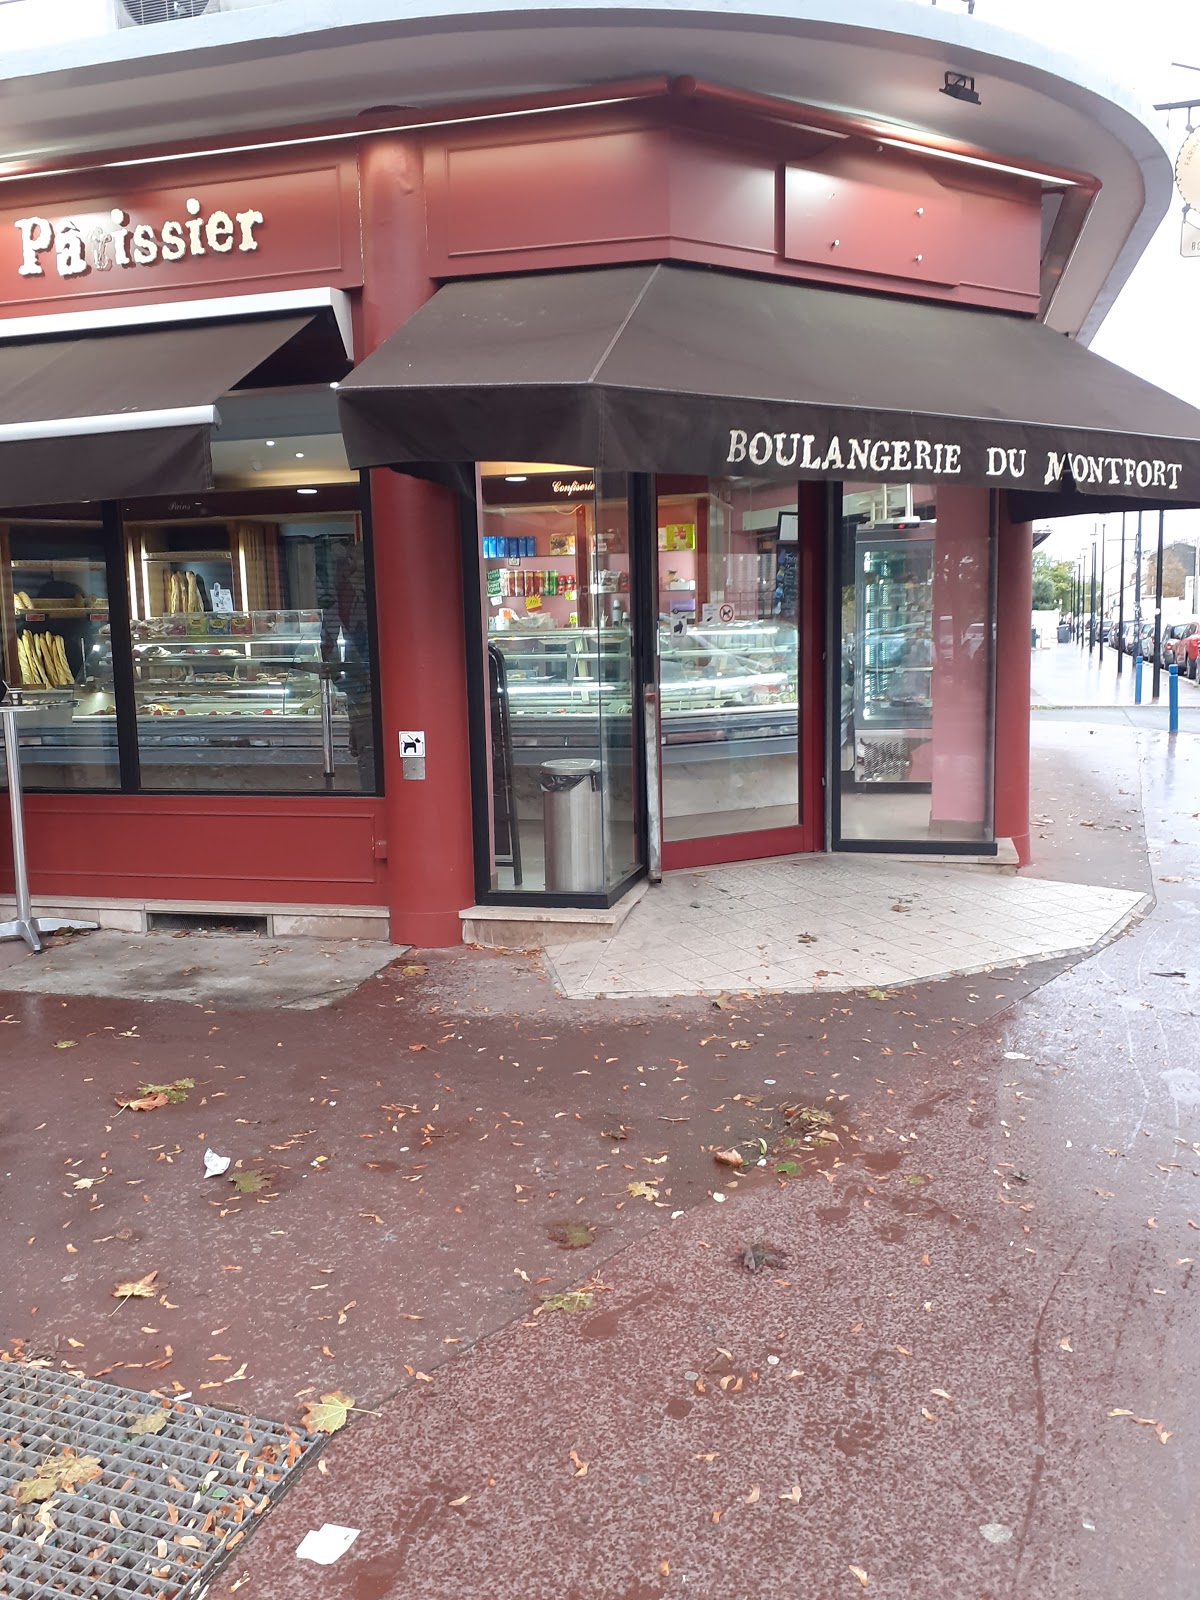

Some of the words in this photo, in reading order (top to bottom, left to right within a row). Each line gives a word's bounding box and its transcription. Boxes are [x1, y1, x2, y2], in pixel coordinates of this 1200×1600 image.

[14, 198, 264, 277] Pâtissier
[726, 429, 962, 475] BOULANGERIE
[986, 447, 1026, 478] DU
[1044, 451, 1183, 490] MONTFORT
[167, 501, 191, 511] Pains
[551, 480, 596, 497] Confiserie
